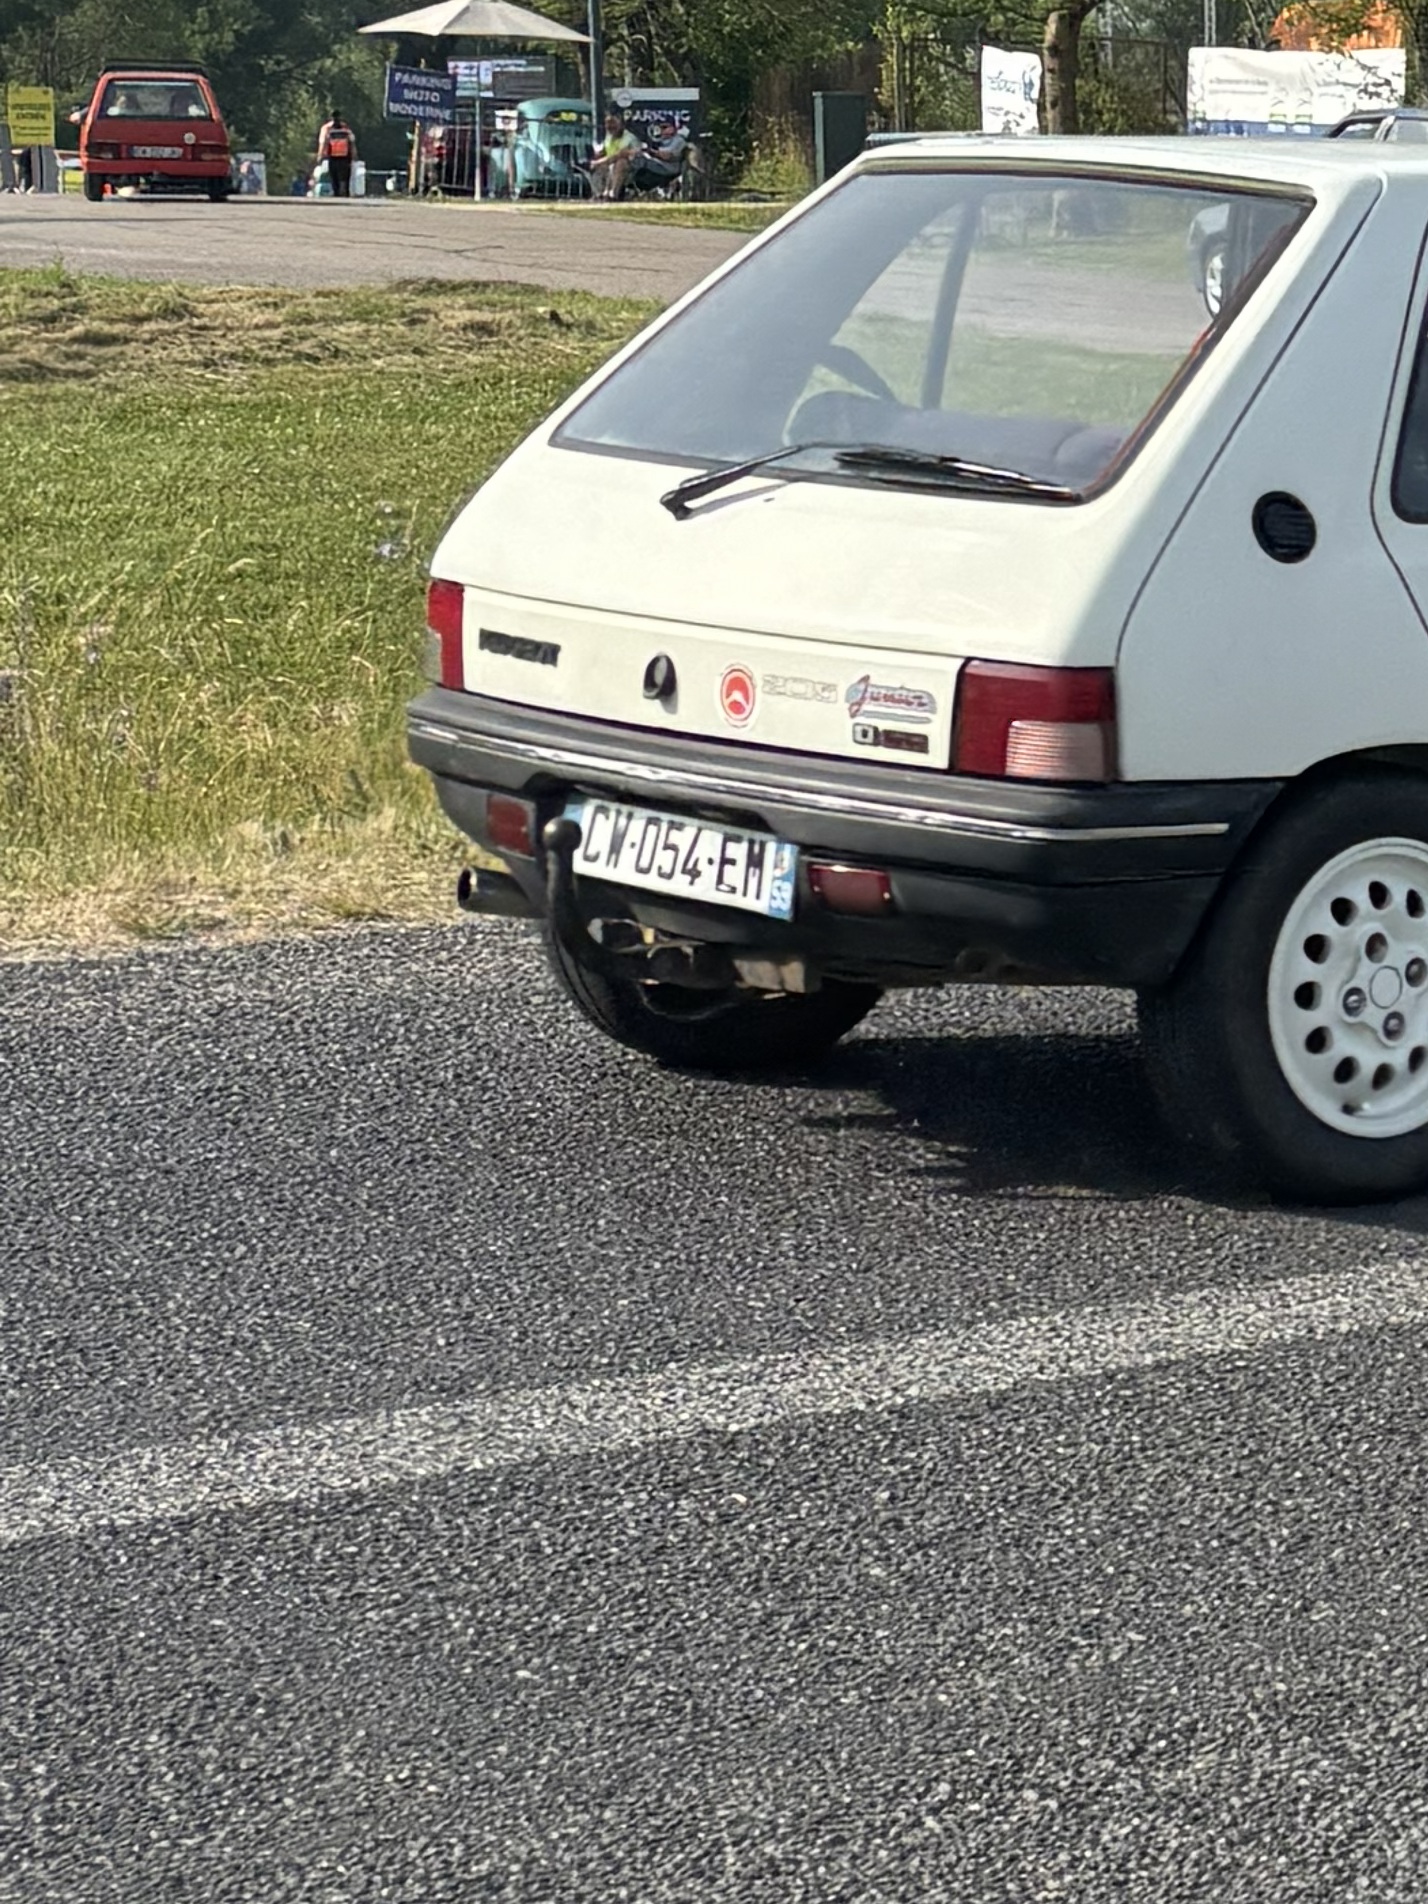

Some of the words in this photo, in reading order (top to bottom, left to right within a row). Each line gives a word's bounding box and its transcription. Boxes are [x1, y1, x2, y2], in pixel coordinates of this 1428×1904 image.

[394, 72, 452, 90] PARKING
[389, 102, 451, 121] MODERNE
[623, 109, 691, 122] PARKING
